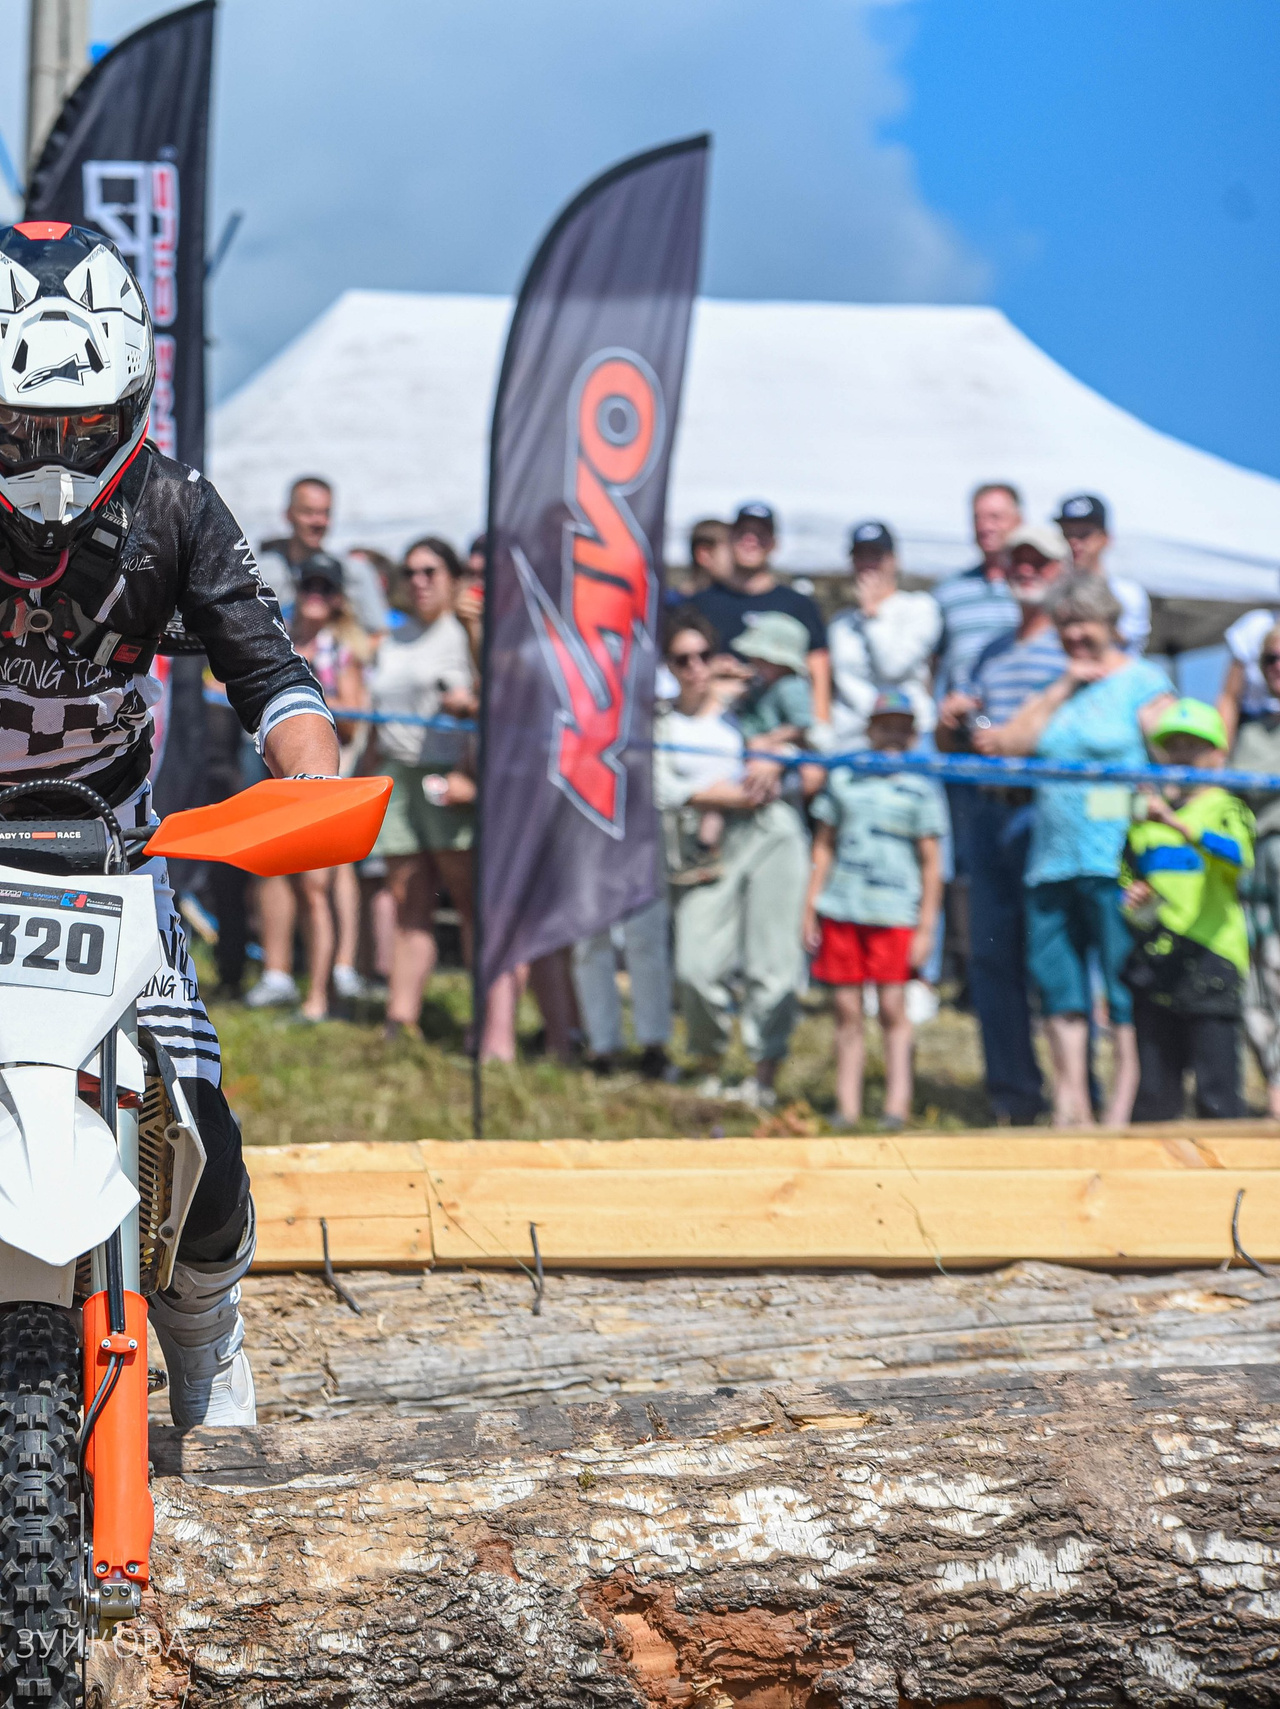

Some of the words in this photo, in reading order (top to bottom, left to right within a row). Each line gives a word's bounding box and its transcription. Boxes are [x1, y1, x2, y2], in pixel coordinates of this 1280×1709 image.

[510, 346, 666, 841] KAYO
[19, 831, 31, 840] TO
[56, 831, 81, 839] RACE
